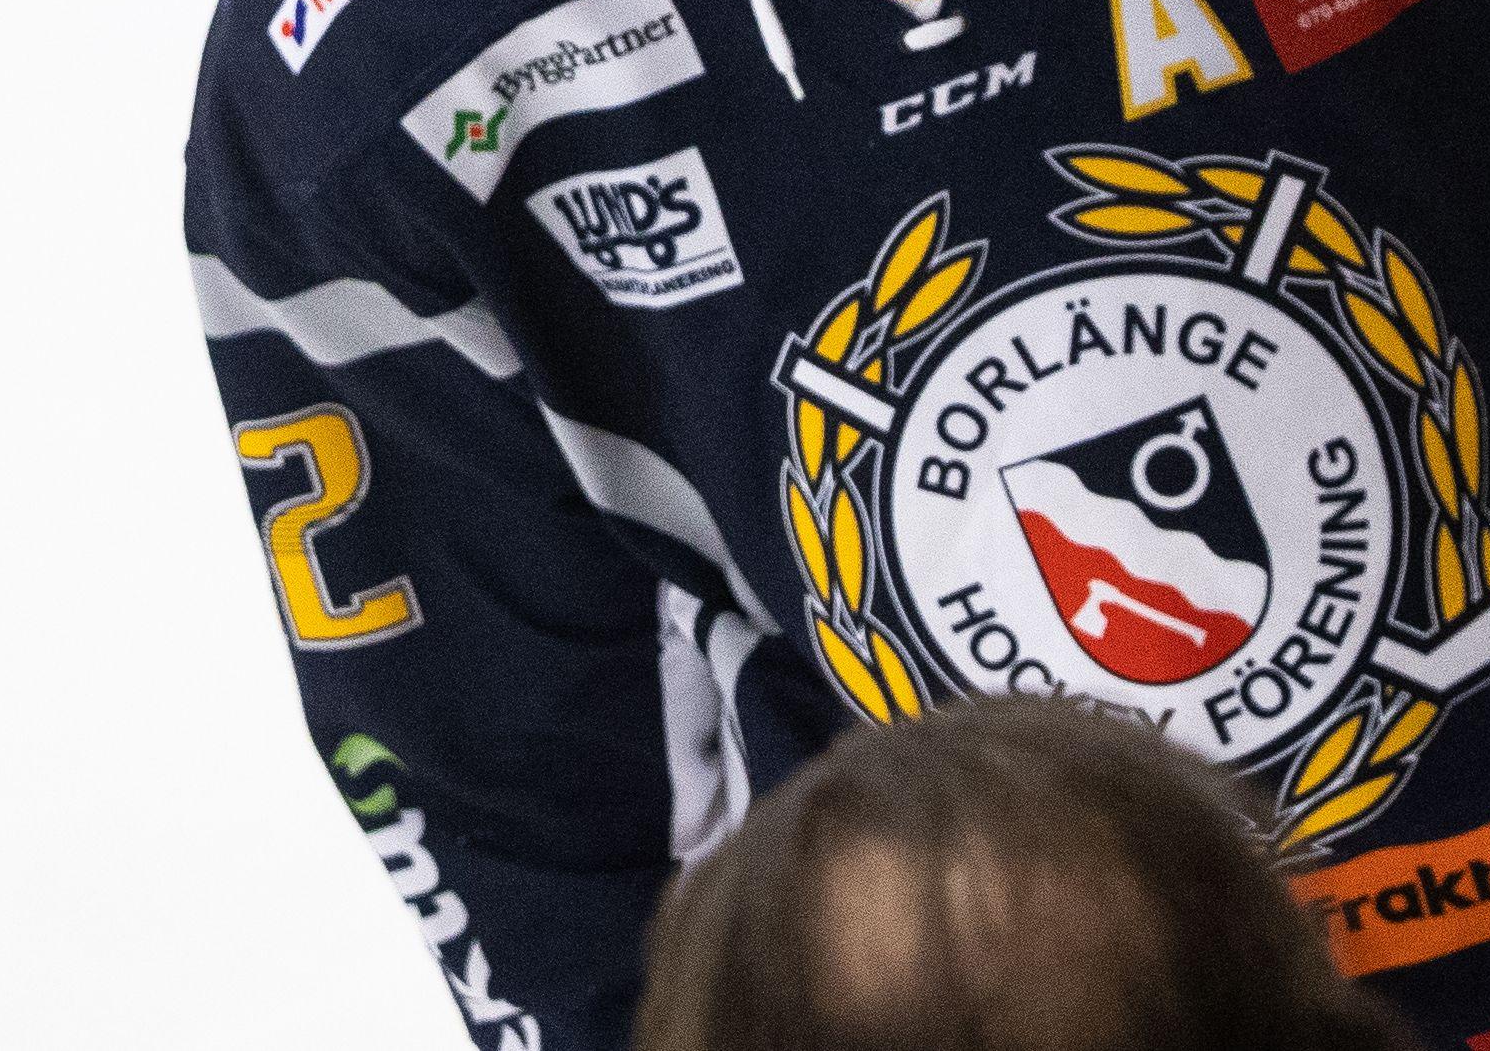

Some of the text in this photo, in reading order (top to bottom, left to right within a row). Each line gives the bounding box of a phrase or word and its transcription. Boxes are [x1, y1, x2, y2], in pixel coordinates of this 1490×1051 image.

[879, 51, 1037, 135] CCM
[916, 296, 1279, 501] BORLÄNGE
[1203, 432, 1371, 747] FÖRENING
